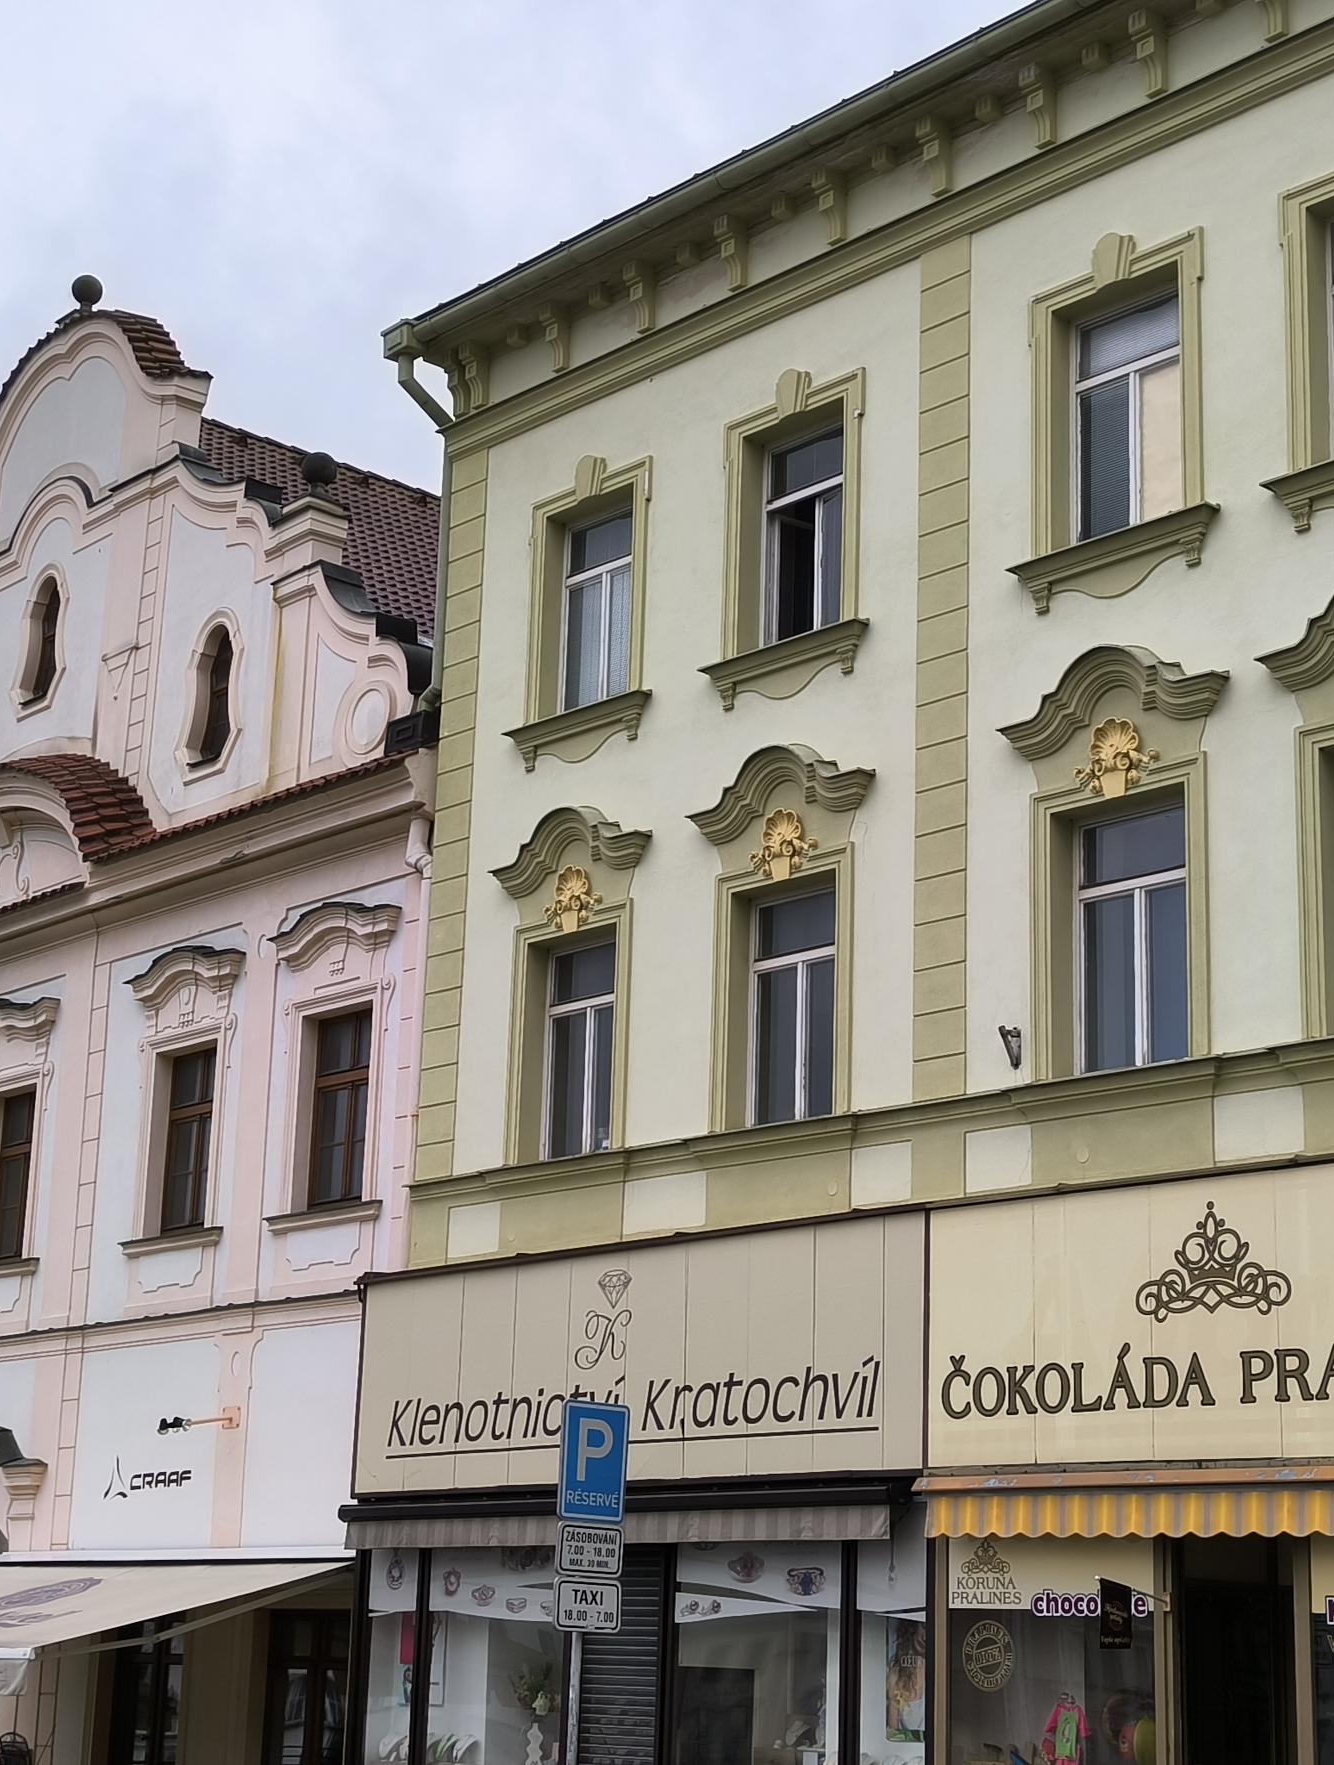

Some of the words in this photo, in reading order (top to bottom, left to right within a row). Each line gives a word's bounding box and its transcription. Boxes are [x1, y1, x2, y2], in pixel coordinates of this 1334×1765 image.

[941, 1341, 1215, 1419] ČOKOLÁDA
[642, 1355, 881, 1432] Kratochvíl
[576, 1417, 614, 1481] P
[129, 1470, 192, 1491] CRAAF
[567, 1488, 619, 1508] RÉSERVÉ
[565, 1529, 618, 1545] ZÁSOBOVÁNÍ
[567, 1544, 585, 1556] 7.00
[593, 1545, 616, 1558] 18.00
[569, 1557, 586, 1568] MAX.
[596, 1559, 612, 1569] MIN.
[956, 1577, 1016, 1590] KORUNA
[572, 1588, 604, 1607] TAXI
[951, 1591, 1022, 1605] PRALINES
[1032, 1589, 1148, 1617] chocoe
[563, 1609, 587, 1622] 18.00
[596, 1611, 615, 1624] 7.00
